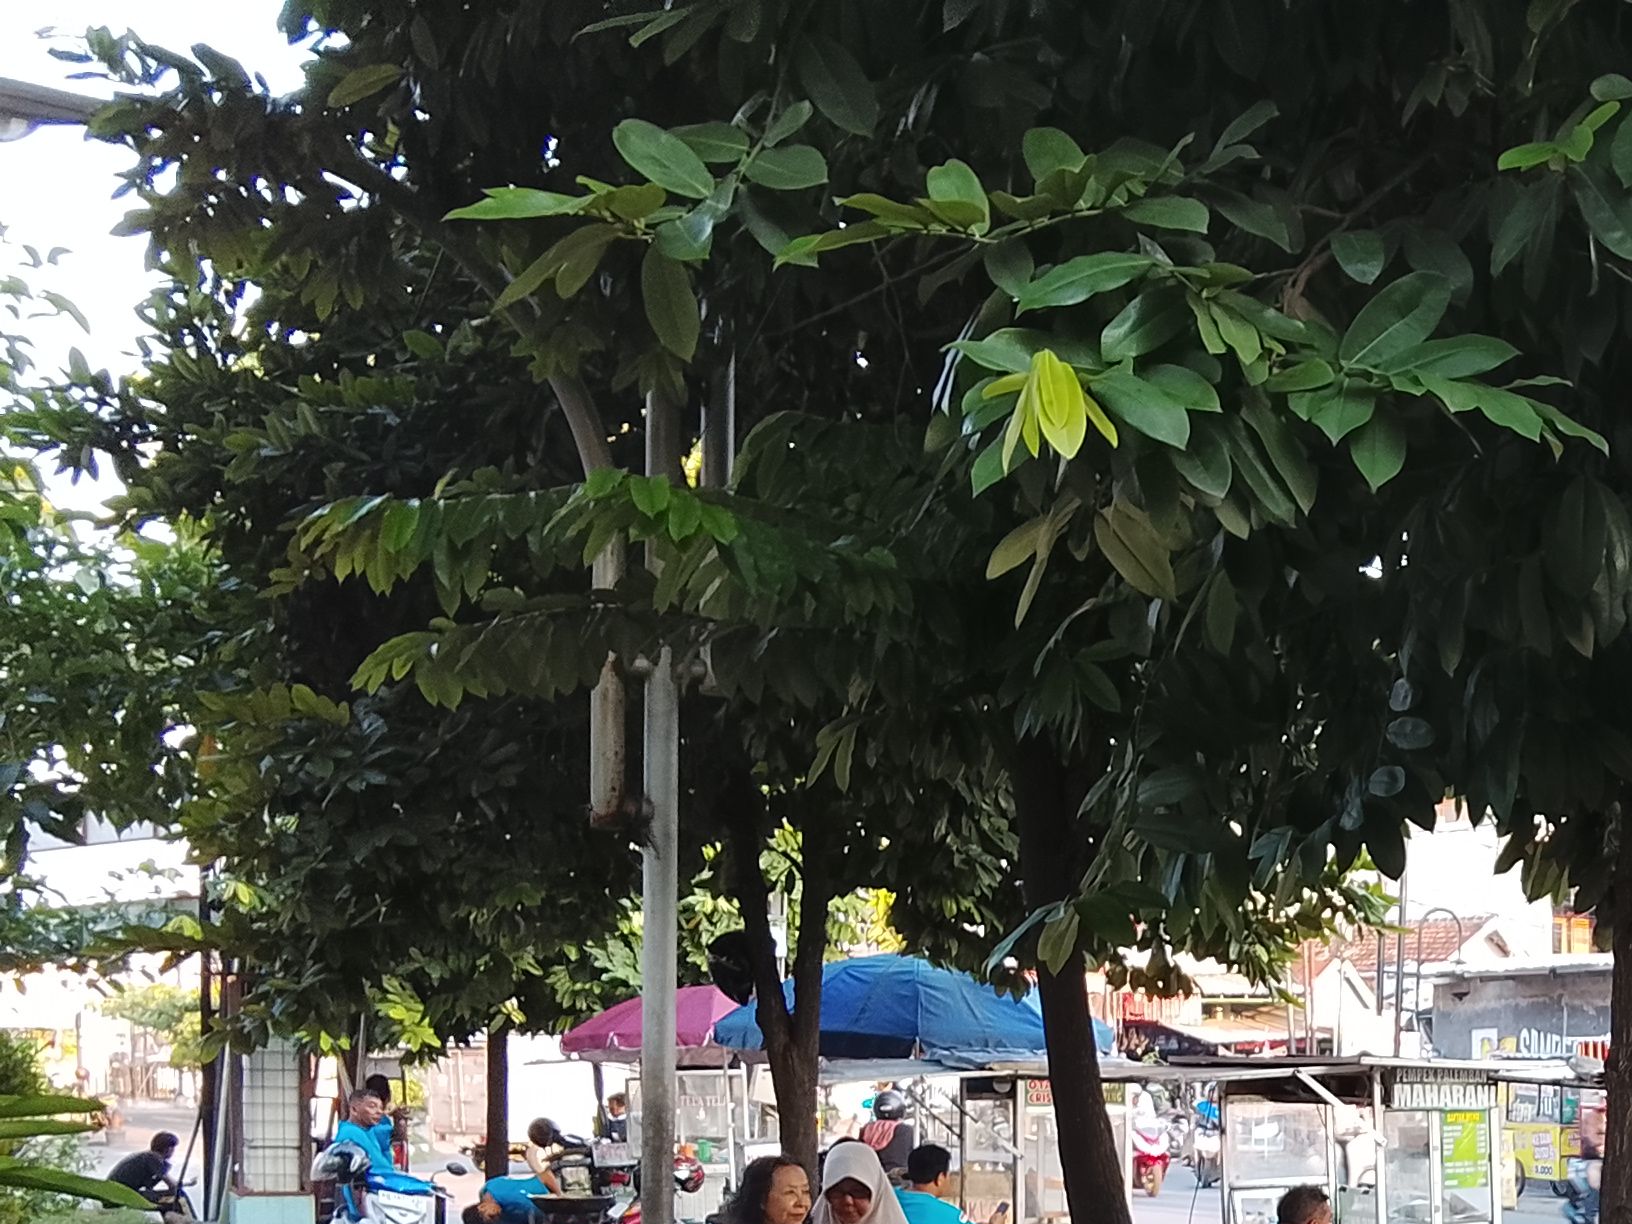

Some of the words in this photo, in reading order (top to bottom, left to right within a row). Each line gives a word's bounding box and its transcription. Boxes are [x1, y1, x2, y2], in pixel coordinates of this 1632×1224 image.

[1396, 1067, 1435, 1082] PEMPEK
[1436, 1068, 1488, 1083] PALEMBAN
[1392, 1083, 1497, 1108] MAHARANI
